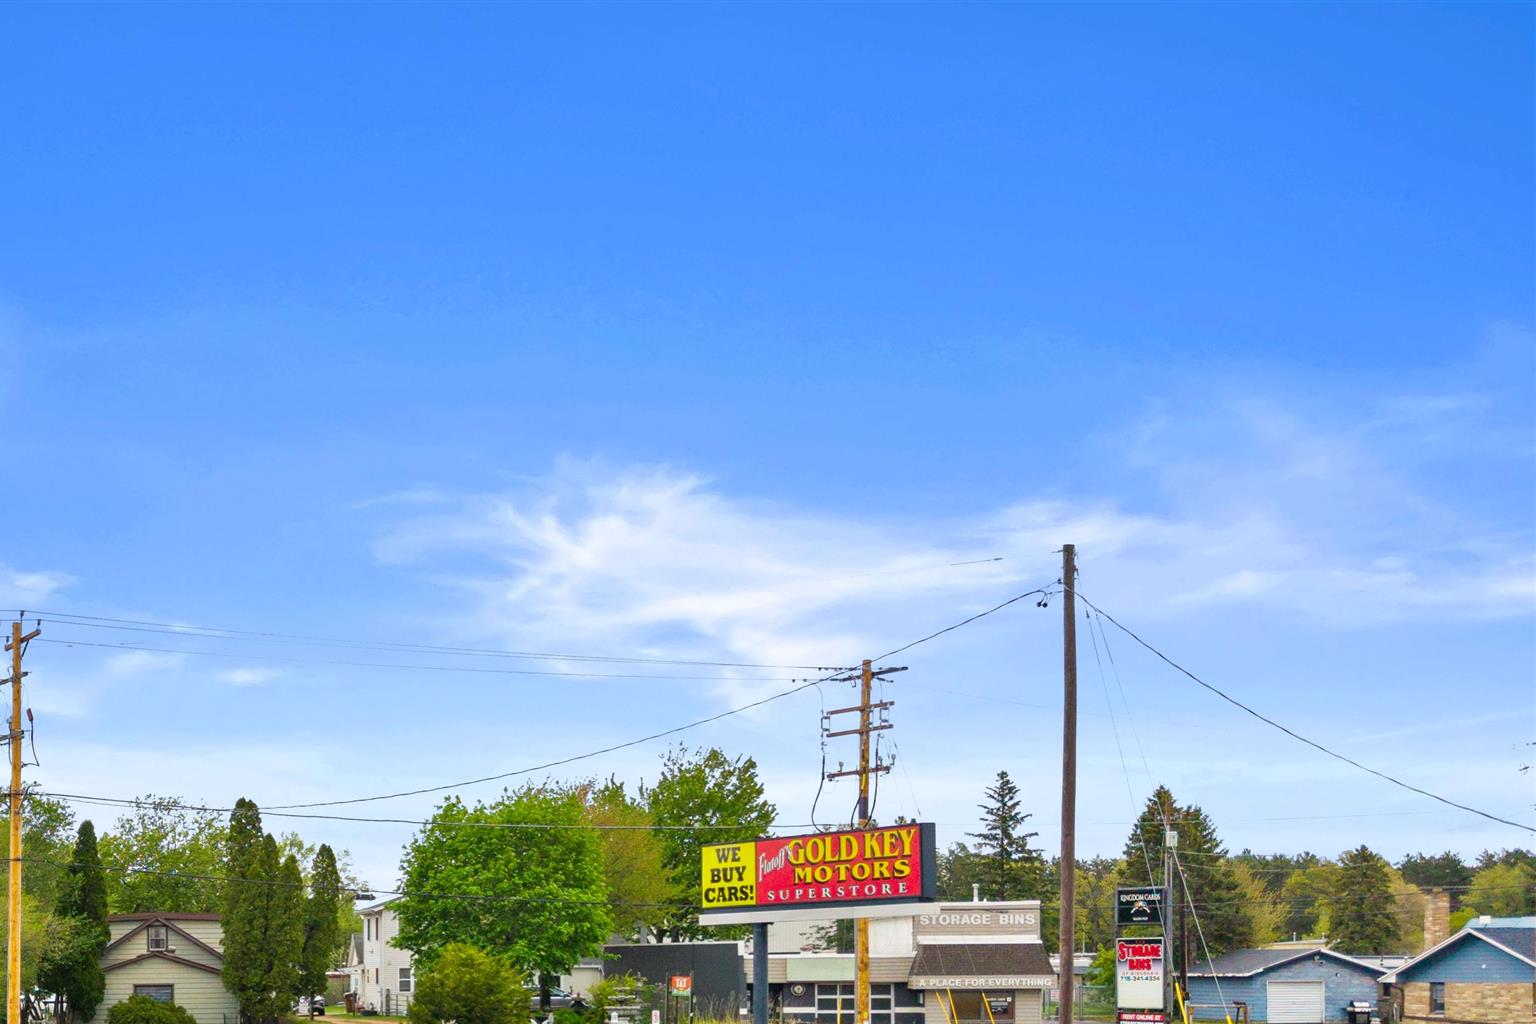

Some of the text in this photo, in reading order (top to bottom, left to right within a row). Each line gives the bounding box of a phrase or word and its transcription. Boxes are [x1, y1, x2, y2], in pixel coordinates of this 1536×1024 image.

[715, 847, 741, 863] WE
[788, 828, 916, 865] GOLD KEY
[710, 866, 747, 883] BUY
[793, 859, 911, 885] MOTORS
[704, 885, 754, 903] CARS!
[767, 882, 908, 901] SUPERSTORE
[919, 913, 1035, 925] STORAGE BINS
[930, 979, 961, 987] PLACE
[989, 978, 1052, 986] EVERYTHING
